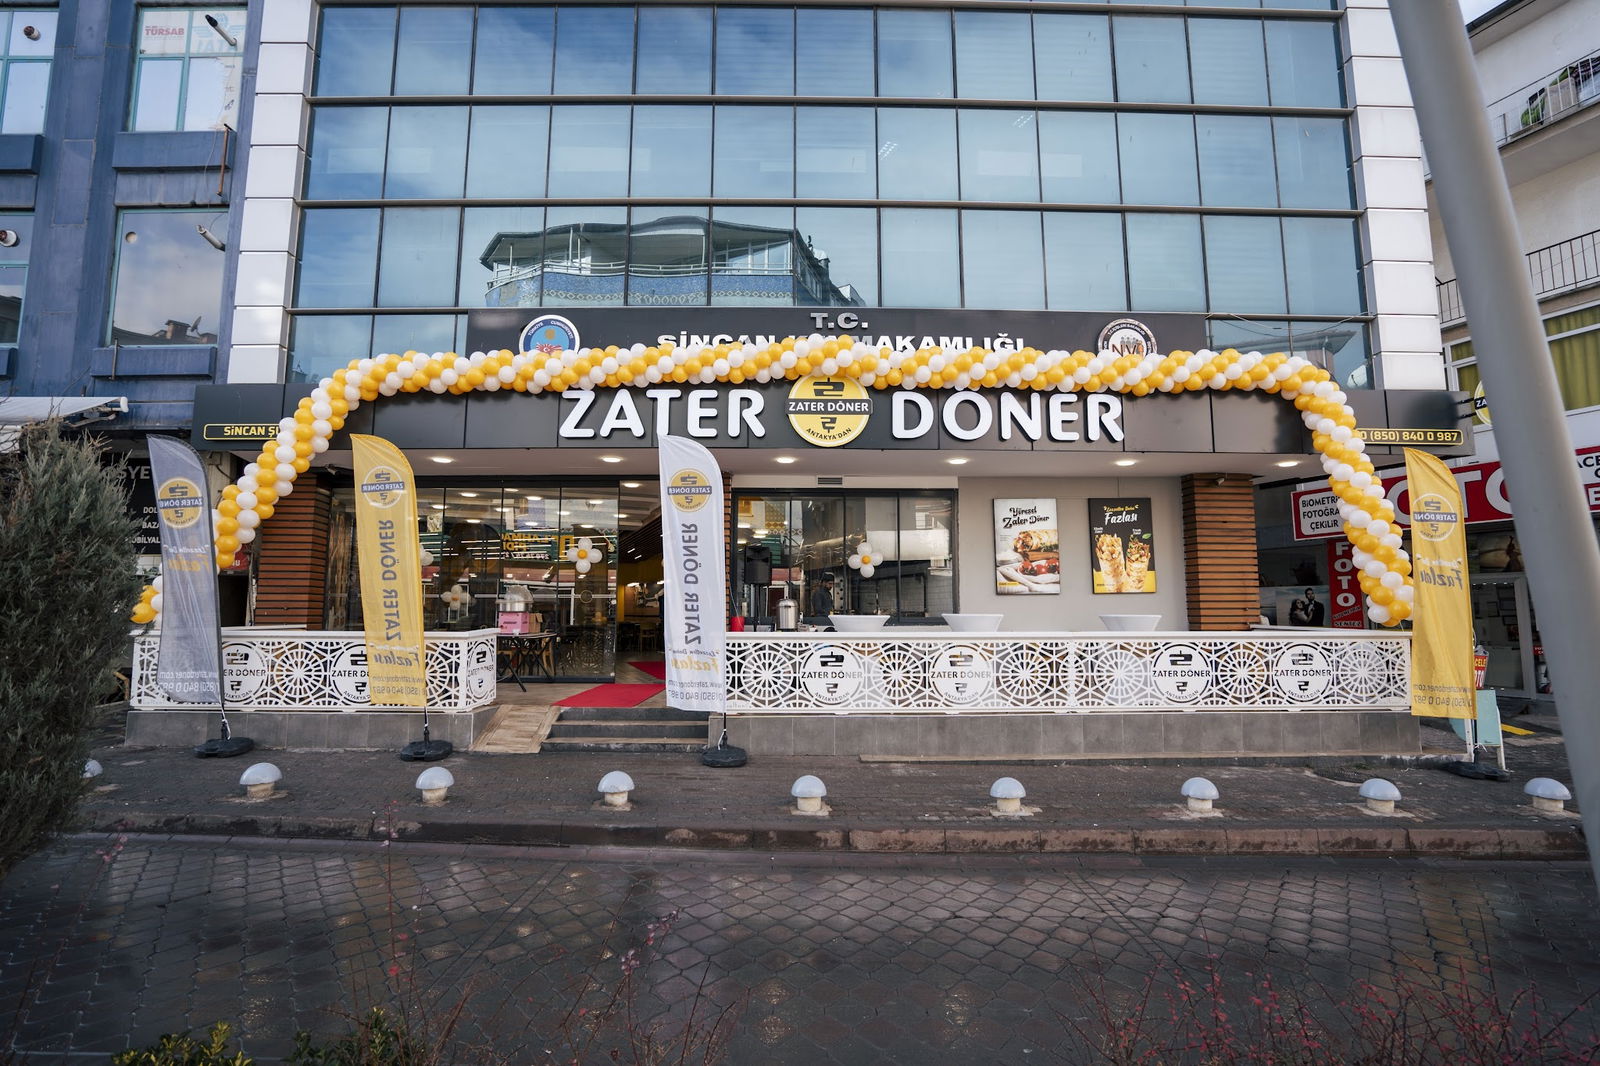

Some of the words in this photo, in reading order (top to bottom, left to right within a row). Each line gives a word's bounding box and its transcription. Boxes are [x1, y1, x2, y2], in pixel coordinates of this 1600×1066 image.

[145, 27, 185, 36] TÜRSAB
[810, 312, 869, 329] T.C.
[788, 401, 825, 412] ZATER
[827, 399, 869, 412] DÖNER
[559, 388, 766, 438] ZATER
[805, 427, 852, 441] ANTAKYA'DAN
[1370, 430, 1399, 442] (850)
[1402, 431, 1425, 441] 840
[1427, 431, 1434, 441] 0
[1437, 431, 1458, 441] 987
[143, 506, 158, 514] DOL
[1009, 506, 1037, 517] Yöresel
[1302, 507, 1340, 519] FOTOĞRA
[1029, 515, 1050, 525] Döner
[1105, 511, 1138, 526] Fazlası
[1334, 542, 1356, 607] FOTO
[331, 669, 358, 678] ZATER
[801, 670, 829, 679] ZATER
[930, 671, 958, 679] ZATER
[1152, 669, 1179, 678] ZATER
[1274, 669, 1300, 677] ZATER
